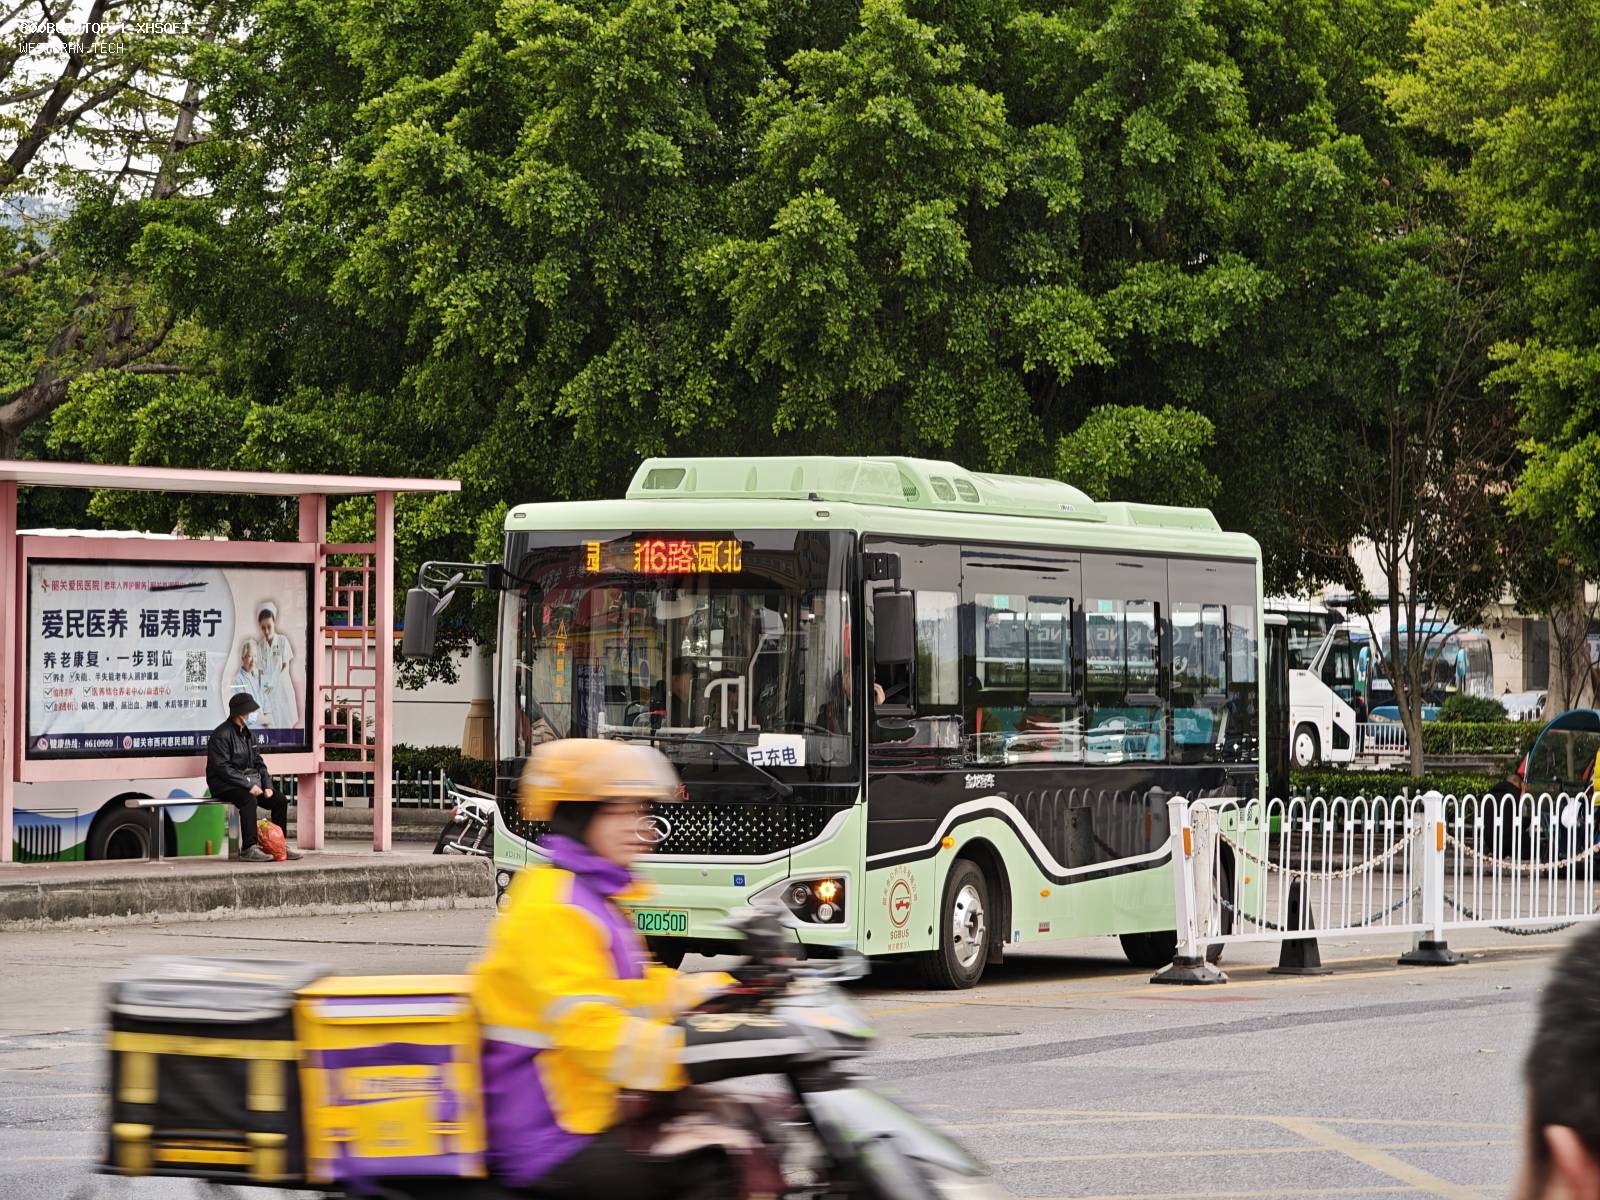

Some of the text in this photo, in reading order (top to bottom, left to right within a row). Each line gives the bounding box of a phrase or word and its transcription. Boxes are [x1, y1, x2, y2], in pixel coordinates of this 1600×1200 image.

[41, 608, 223, 639] 爱民医养 福寿康宁
[133, 735, 211, 748] 韶关市西河惠民南路（西
[750, 746, 798, 767] 已充电
[637, 913, 687, 932] 02050D
[890, 928, 910, 940] SGBUS
